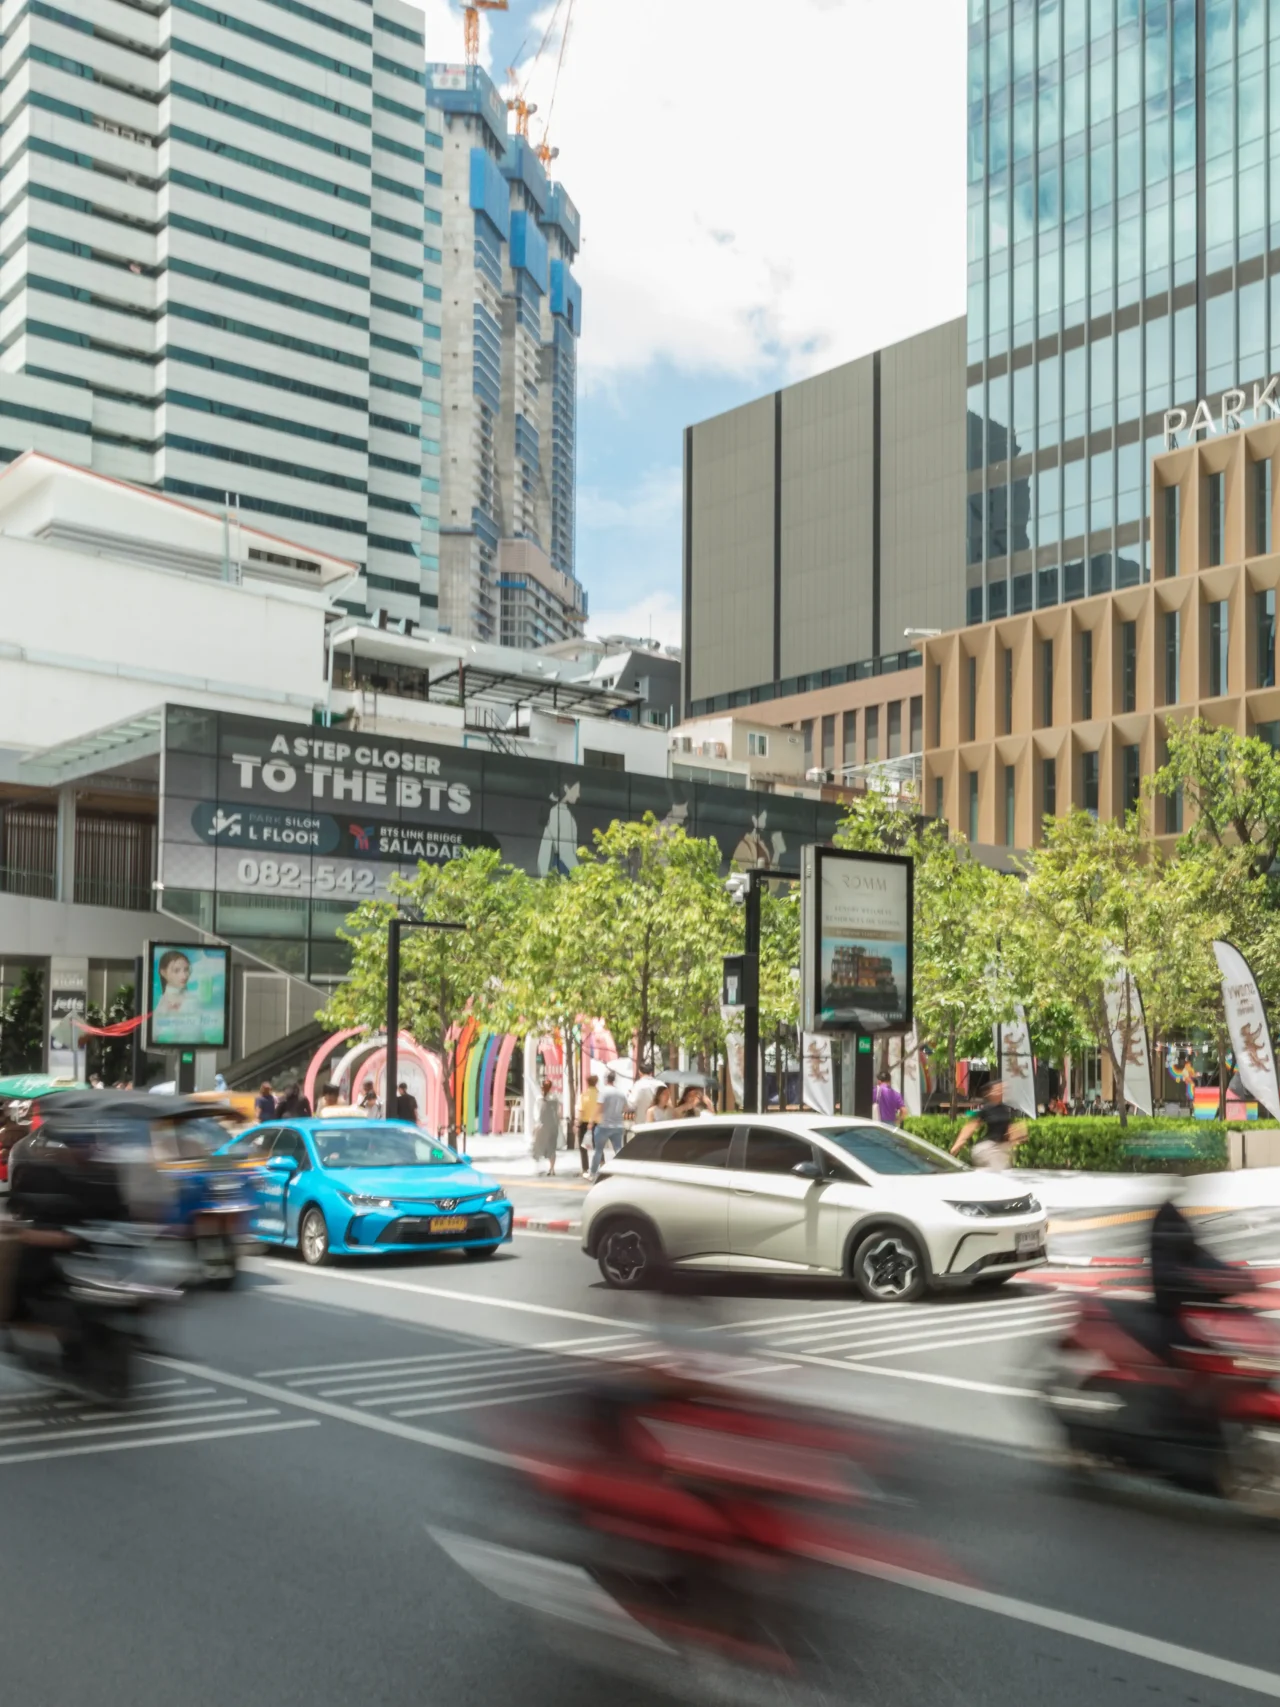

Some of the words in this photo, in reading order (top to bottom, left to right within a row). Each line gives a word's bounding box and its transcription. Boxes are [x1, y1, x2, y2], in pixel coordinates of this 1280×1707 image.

[270, 734, 289, 755] A
[294, 737, 351, 762] STEP
[355, 745, 440, 776] CLOSER
[232, 753, 297, 793] TO
[305, 762, 387, 805] THE
[396, 775, 471, 814] BTS
[249, 813, 281, 824] PARK
[285, 815, 320, 829] SILOM
[249, 825, 258, 840] L
[263, 826, 319, 846] FLOOR
[380, 826, 399, 838] BTS
[401, 828, 424, 841] LINK
[427, 831, 463, 844] BRIDGE
[841, 874, 888, 894] ROMM
